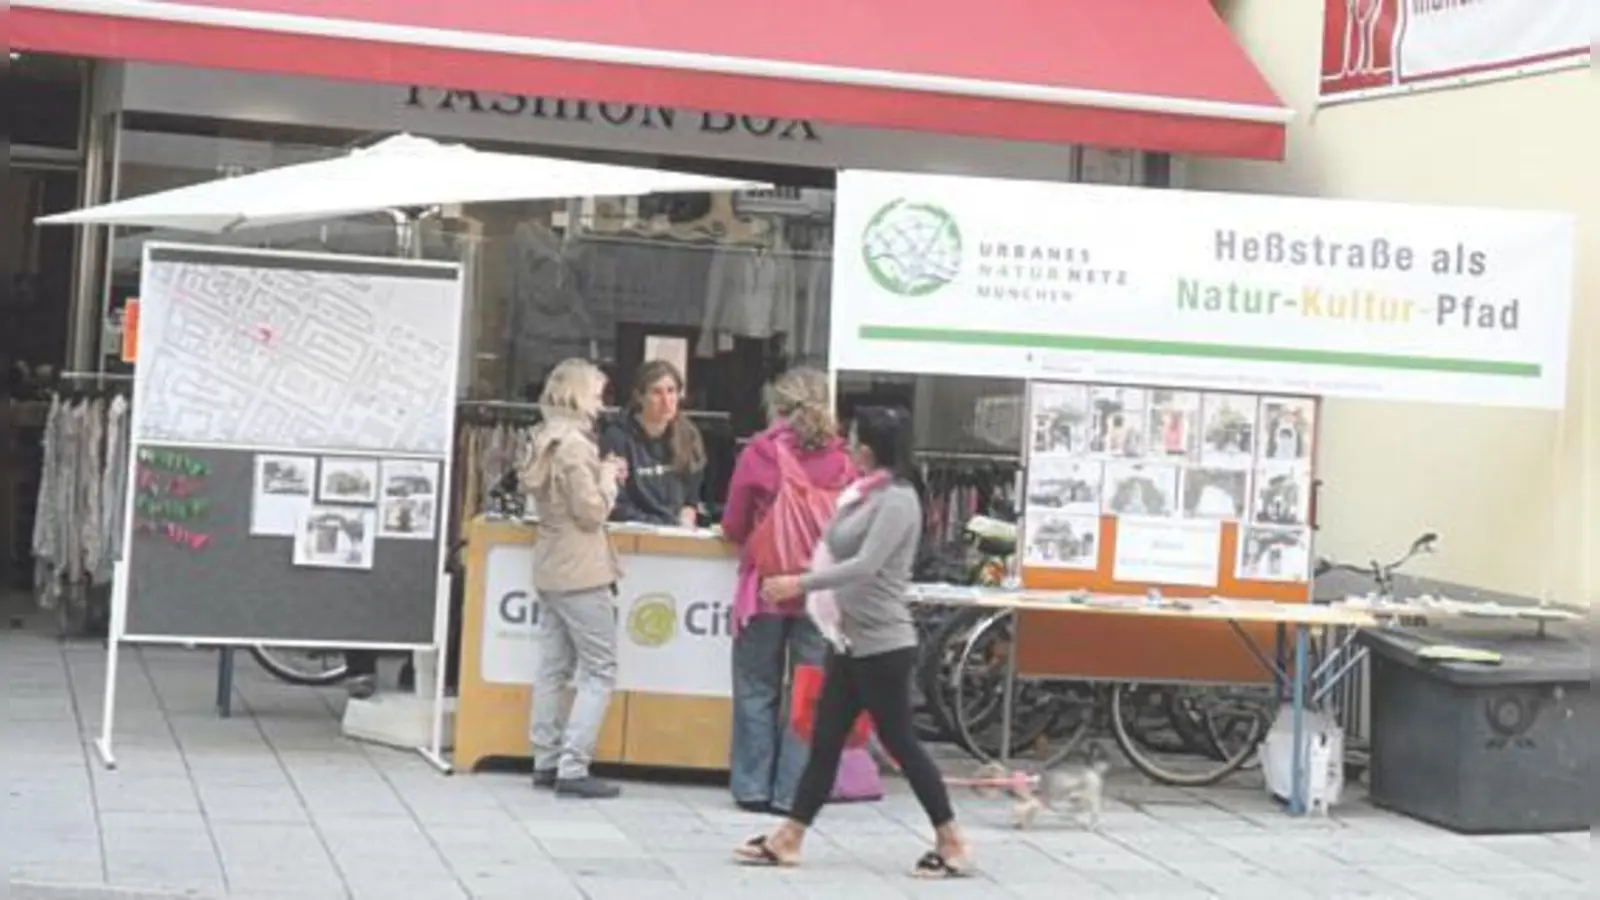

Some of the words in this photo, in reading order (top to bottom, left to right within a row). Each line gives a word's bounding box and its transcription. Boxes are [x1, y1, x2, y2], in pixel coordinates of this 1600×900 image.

[980, 241, 1090, 263] URBANES
[1213, 228, 1416, 274] Heßstraße
[1431, 243, 1487, 277] als
[685, 600, 734, 637] Cit
